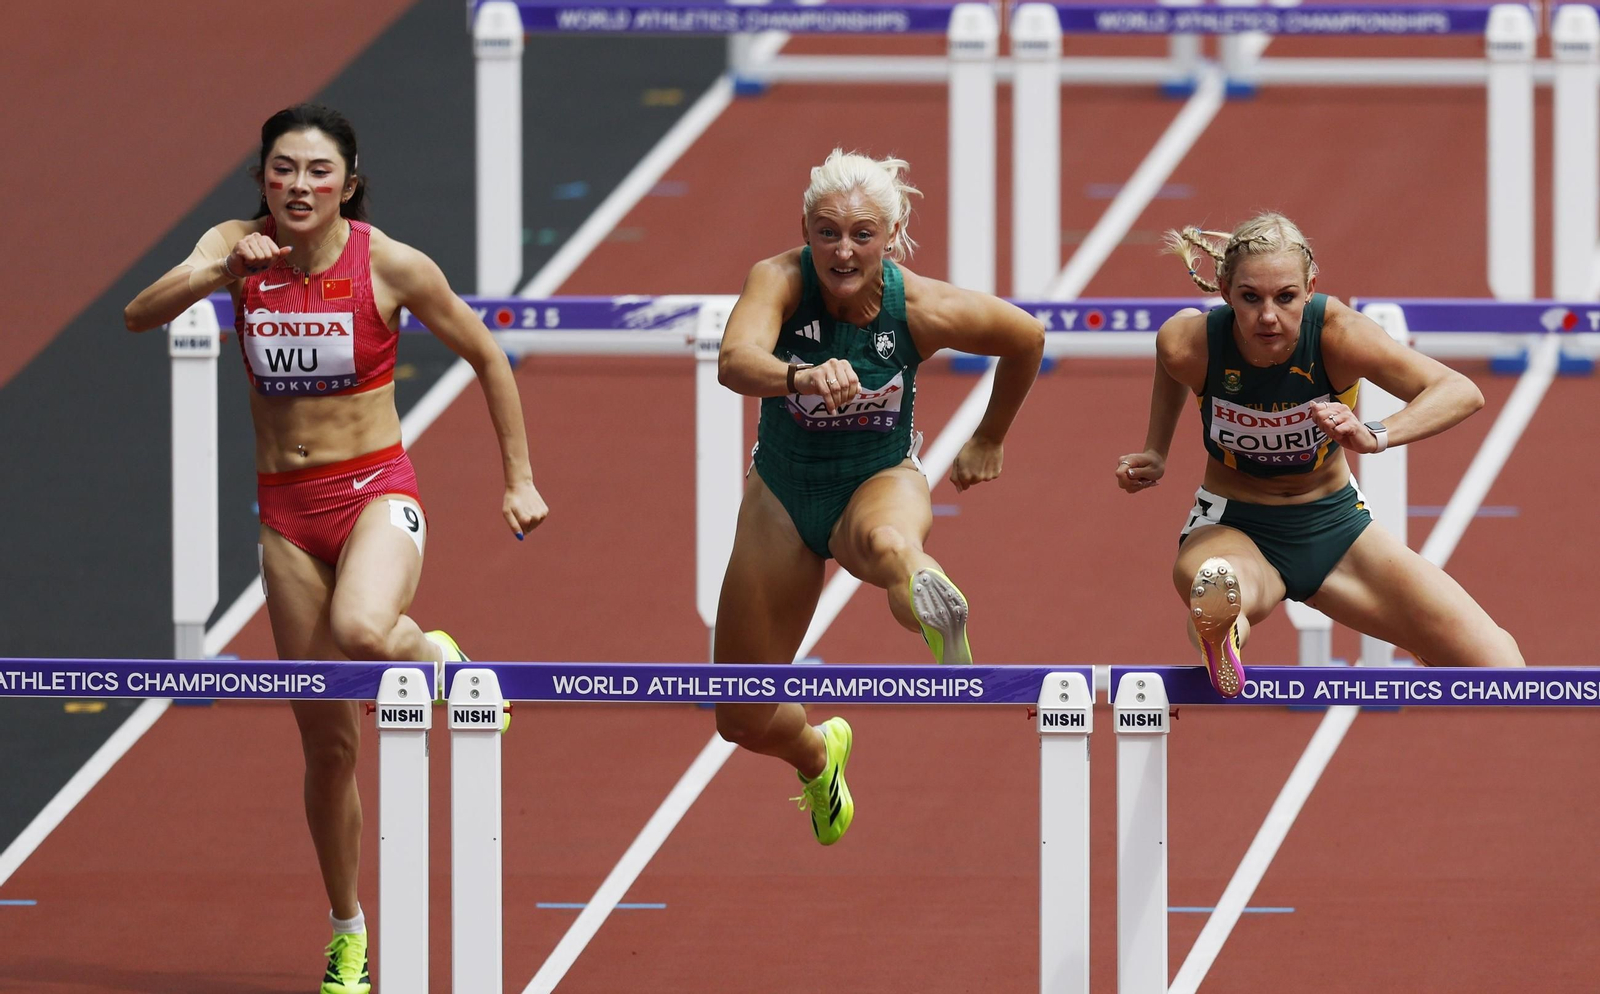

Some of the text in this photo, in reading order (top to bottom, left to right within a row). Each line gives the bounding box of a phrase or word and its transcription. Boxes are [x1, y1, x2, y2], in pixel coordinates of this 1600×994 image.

[265, 348, 318, 373] WU
[1219, 425, 1326, 451] FOURIE
[403, 506, 419, 533] 9
[127, 672, 326, 693] CHAMPIONSHIPS
[552, 675, 984, 698] WORLD ATHLETICS CHAMPIONSHIPS
[1223, 680, 1600, 700] ORLD ATHLETICS CHAMPIONS
[381, 709, 423, 722] NISHI
[453, 710, 496, 723] NISHI
[1042, 713, 1085, 727] NISHI
[1119, 713, 1162, 727] NISHI
